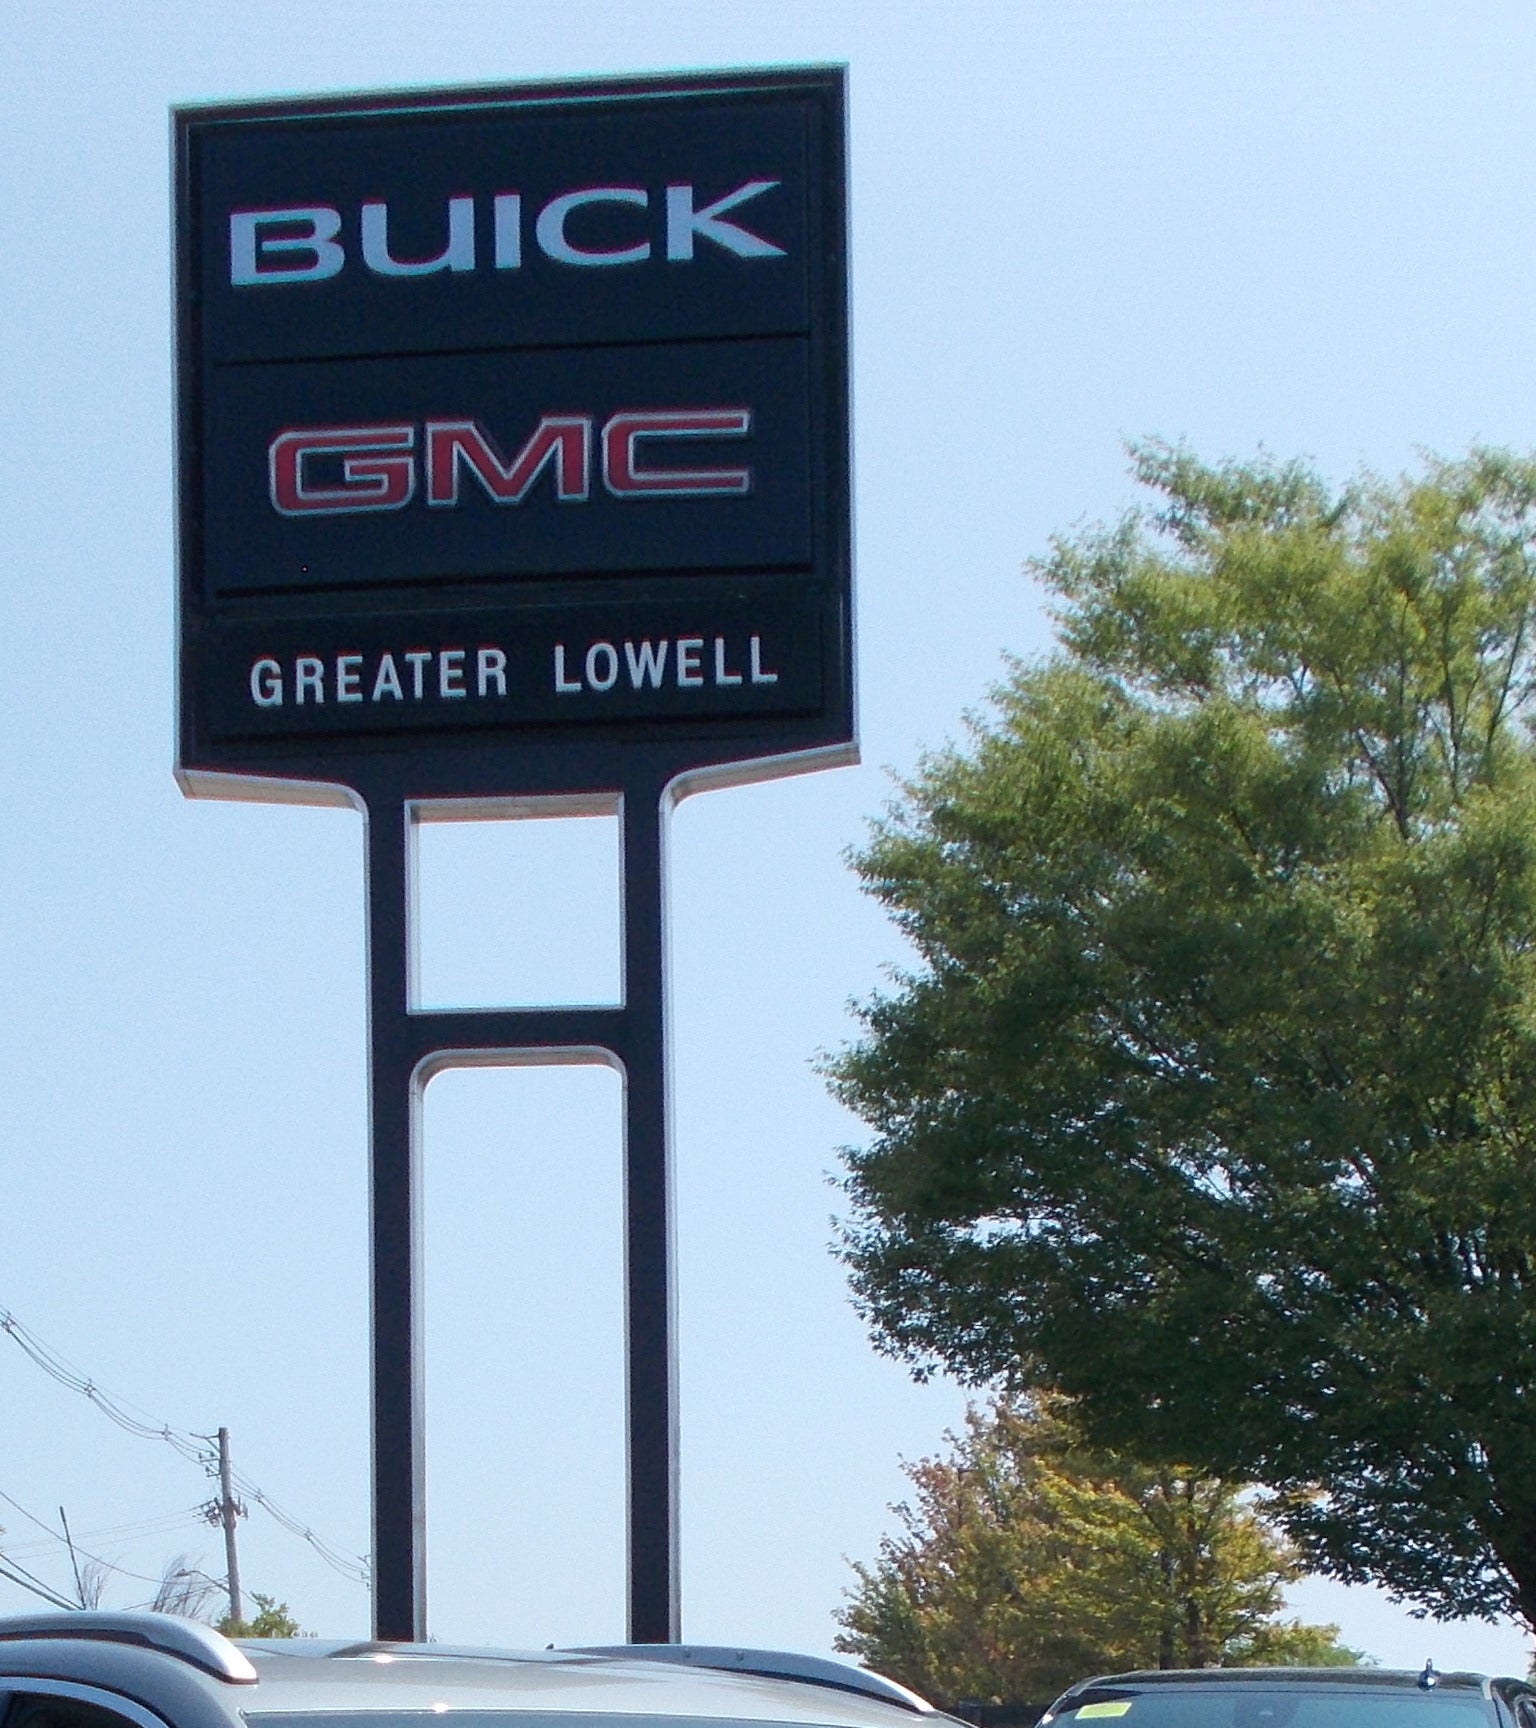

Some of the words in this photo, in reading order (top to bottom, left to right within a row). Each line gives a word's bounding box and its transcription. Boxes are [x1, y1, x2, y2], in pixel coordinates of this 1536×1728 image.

[229, 180, 789, 287] BUICK
[268, 408, 751, 516] GMC
[249, 648, 509, 708] GREATER
[554, 635, 779, 693] LOWELL
